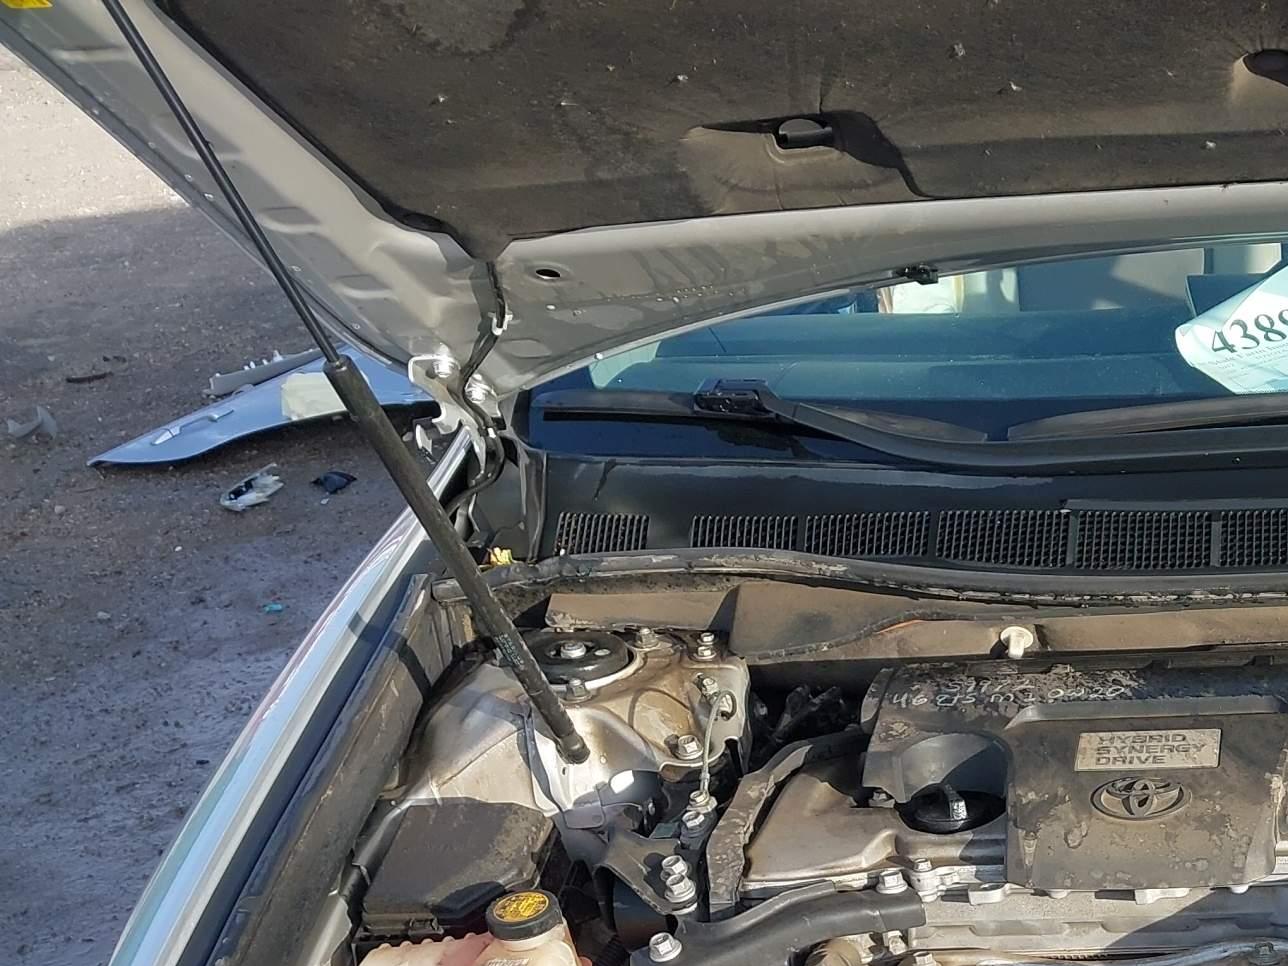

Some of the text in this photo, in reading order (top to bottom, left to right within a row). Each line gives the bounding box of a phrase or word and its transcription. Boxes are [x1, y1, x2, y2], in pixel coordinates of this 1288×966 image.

[1098, 733, 1187, 745] HYBRID
[1096, 743, 1206, 755] SYNERGY
[1095, 755, 1167, 766] DRIVE
